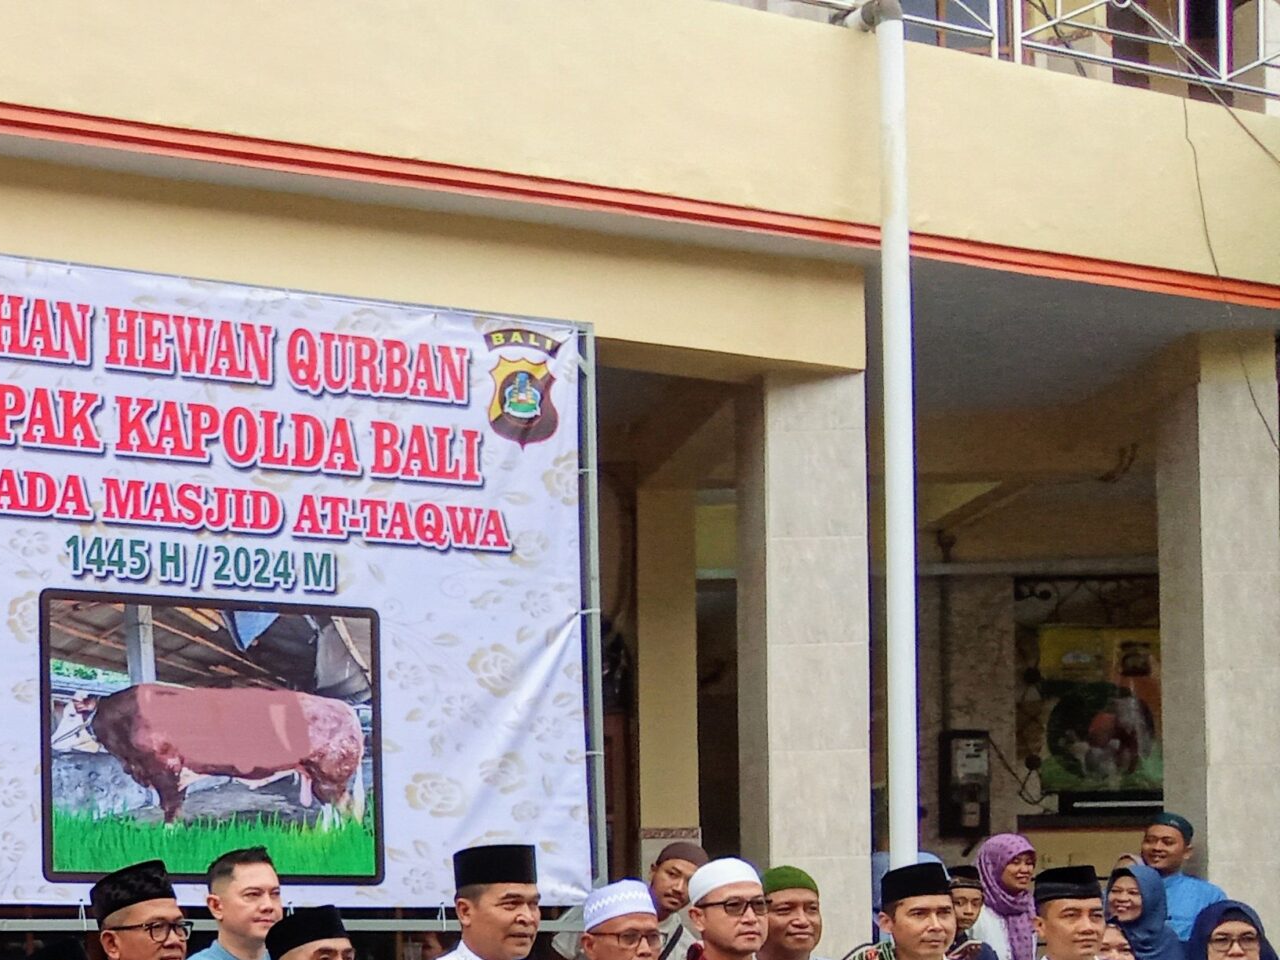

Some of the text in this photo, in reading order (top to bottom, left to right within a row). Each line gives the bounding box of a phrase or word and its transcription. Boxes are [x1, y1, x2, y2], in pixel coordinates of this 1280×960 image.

[104, 306, 273, 382] HEWAN
[286, 327, 468, 402] QURBAN
[491, 331, 554, 351] BALI
[114, 395, 359, 473] KAPOLDA
[369, 420, 481, 482] BALI
[101, 477, 283, 530] MASJID
[292, 493, 511, 548] AT-TAQWA
[65, 534, 148, 576] 1445
[159, 541, 182, 578] H
[213, 545, 294, 586] 2024
[303, 551, 336, 589] M
